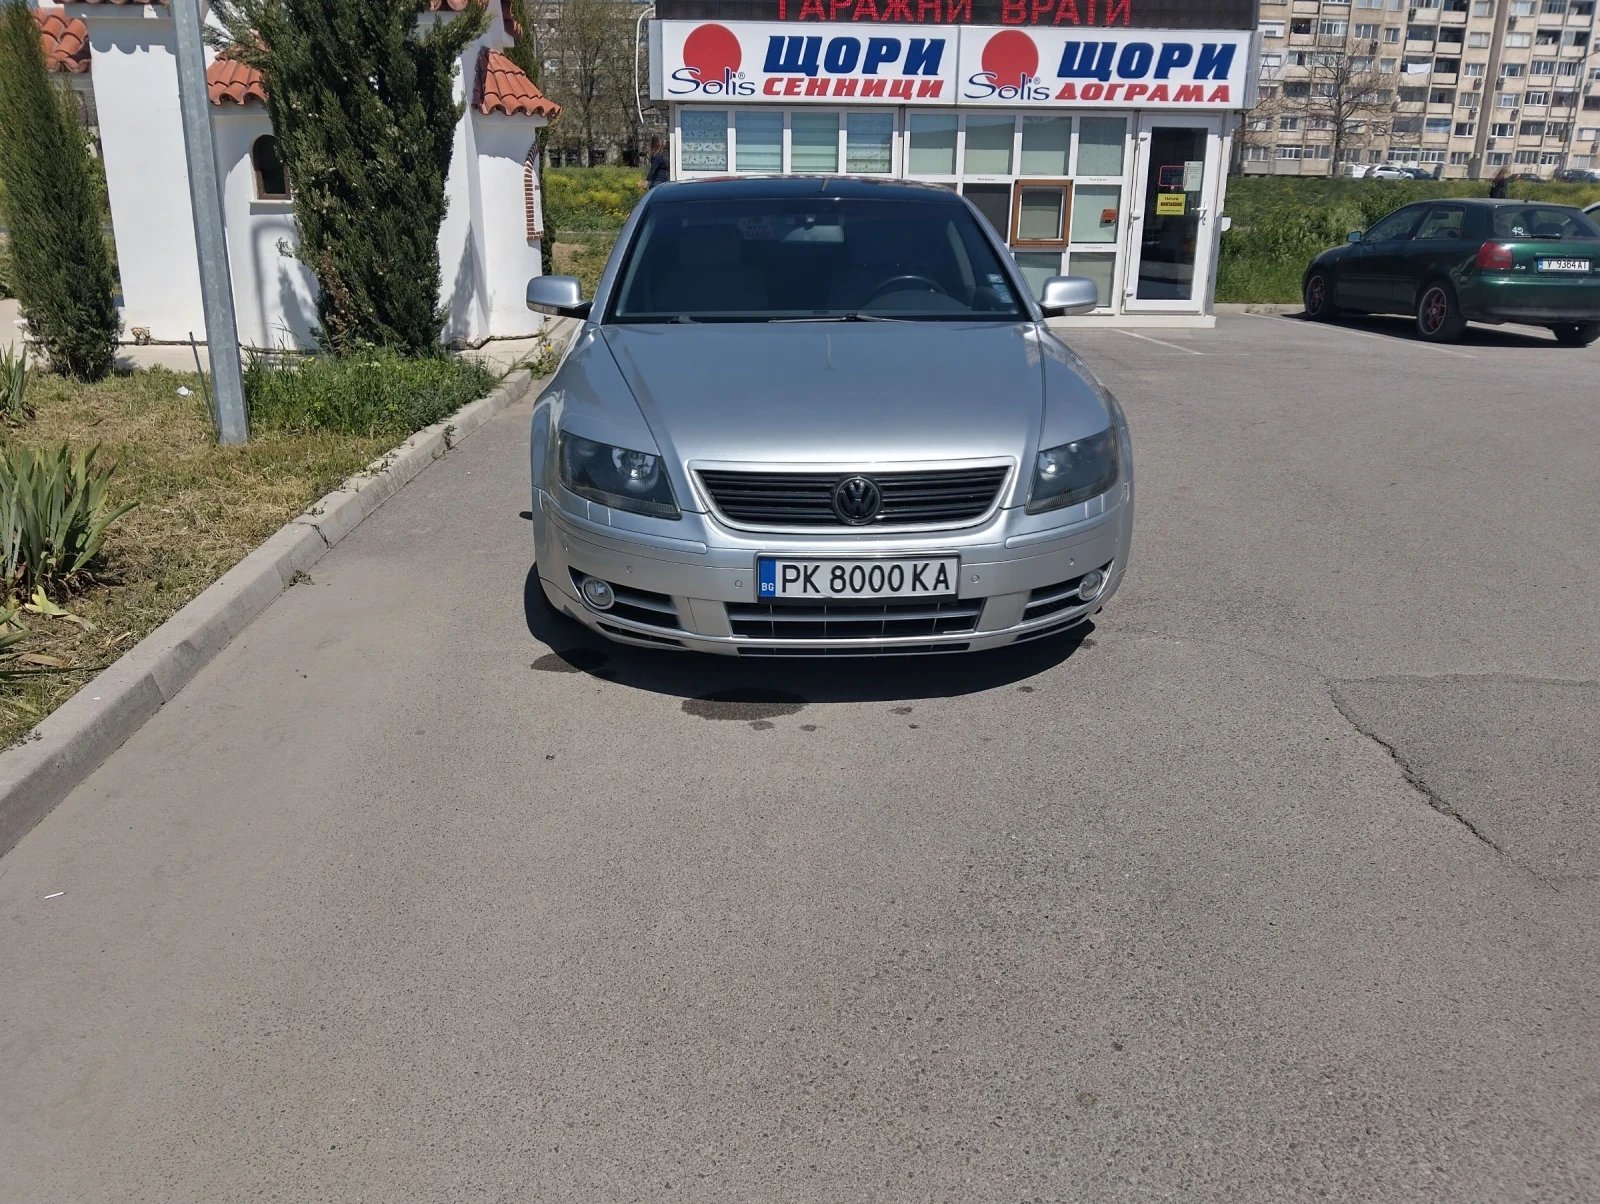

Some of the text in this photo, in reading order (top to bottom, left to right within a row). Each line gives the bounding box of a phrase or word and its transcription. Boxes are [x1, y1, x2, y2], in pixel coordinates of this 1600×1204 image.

[763, 35, 946, 77] ЩОРИ
[1056, 41, 1237, 82] ЩОРИ
[762, 77, 945, 100] СЕННИЦИ
[1054, 83, 1231, 103] ДОГРАМА
[761, 582, 775, 592] BG
[781, 562, 950, 594] PK 8000 KA
